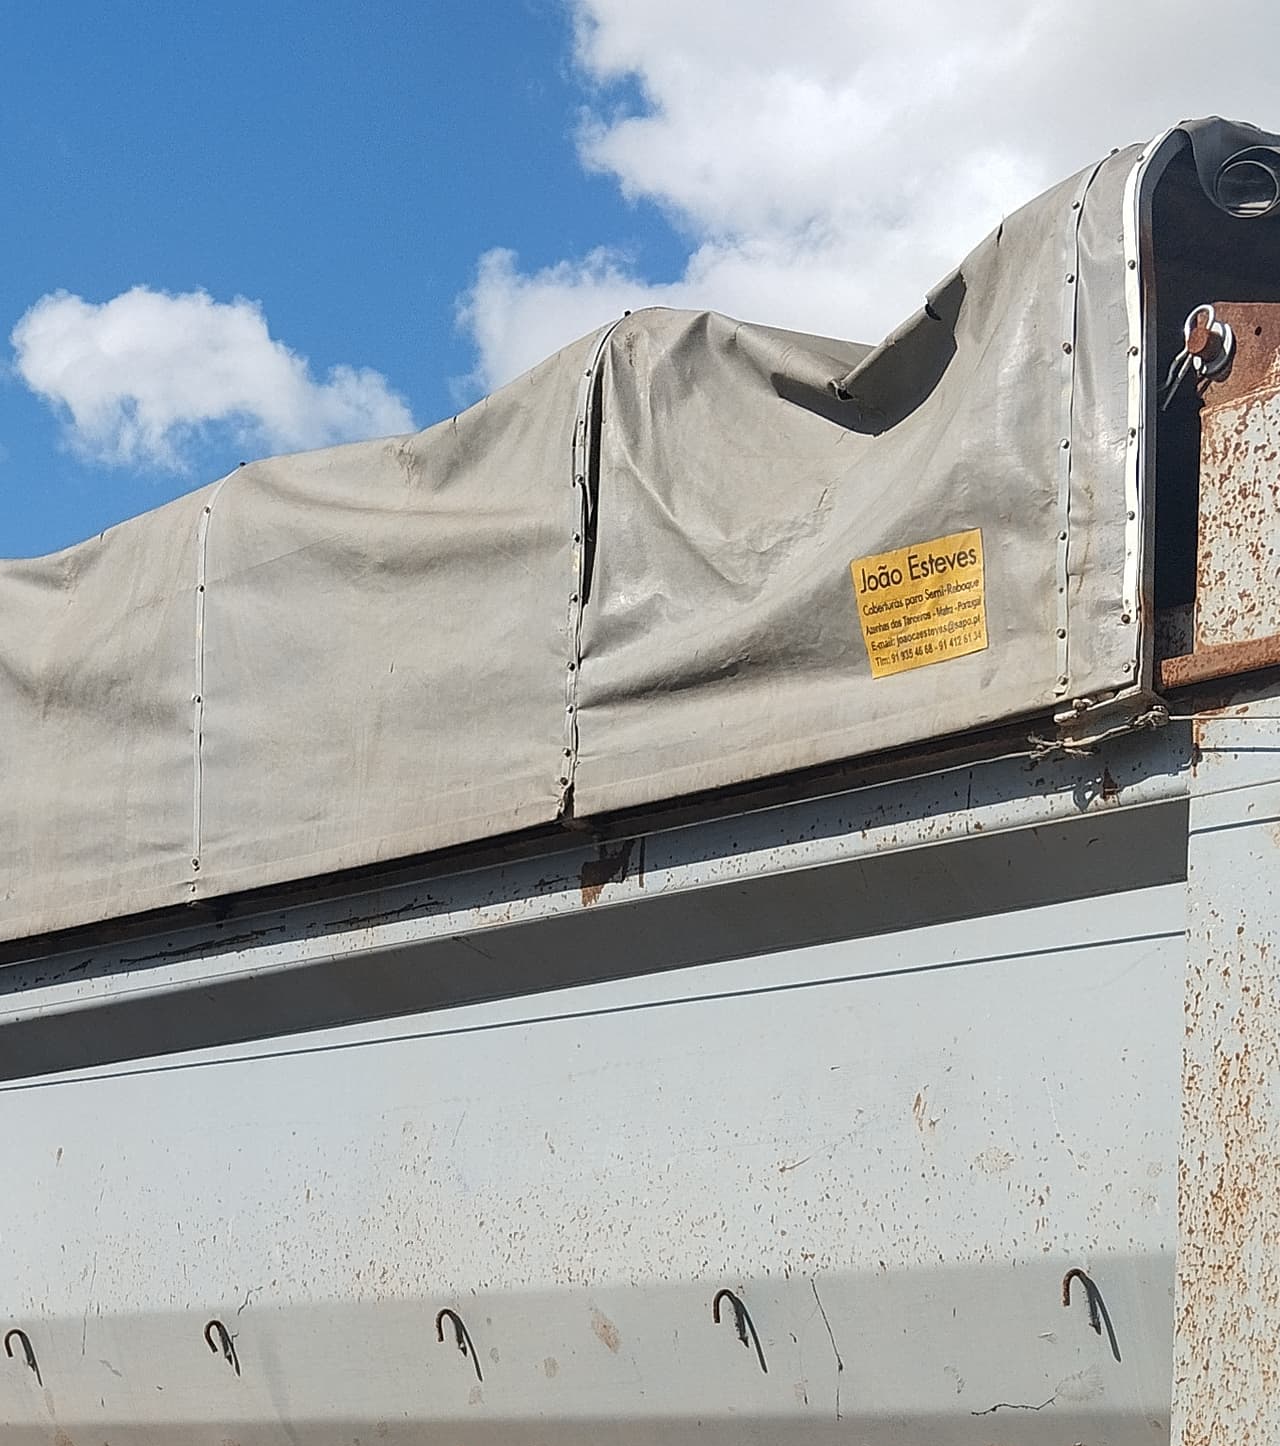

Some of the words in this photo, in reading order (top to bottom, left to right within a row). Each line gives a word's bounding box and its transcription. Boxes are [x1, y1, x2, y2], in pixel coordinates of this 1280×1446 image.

[860, 565, 903, 594] João
[907, 548, 978, 581] Esteves
[862, 600, 904, 617] Coberturas
[904, 591, 924, 610] para
